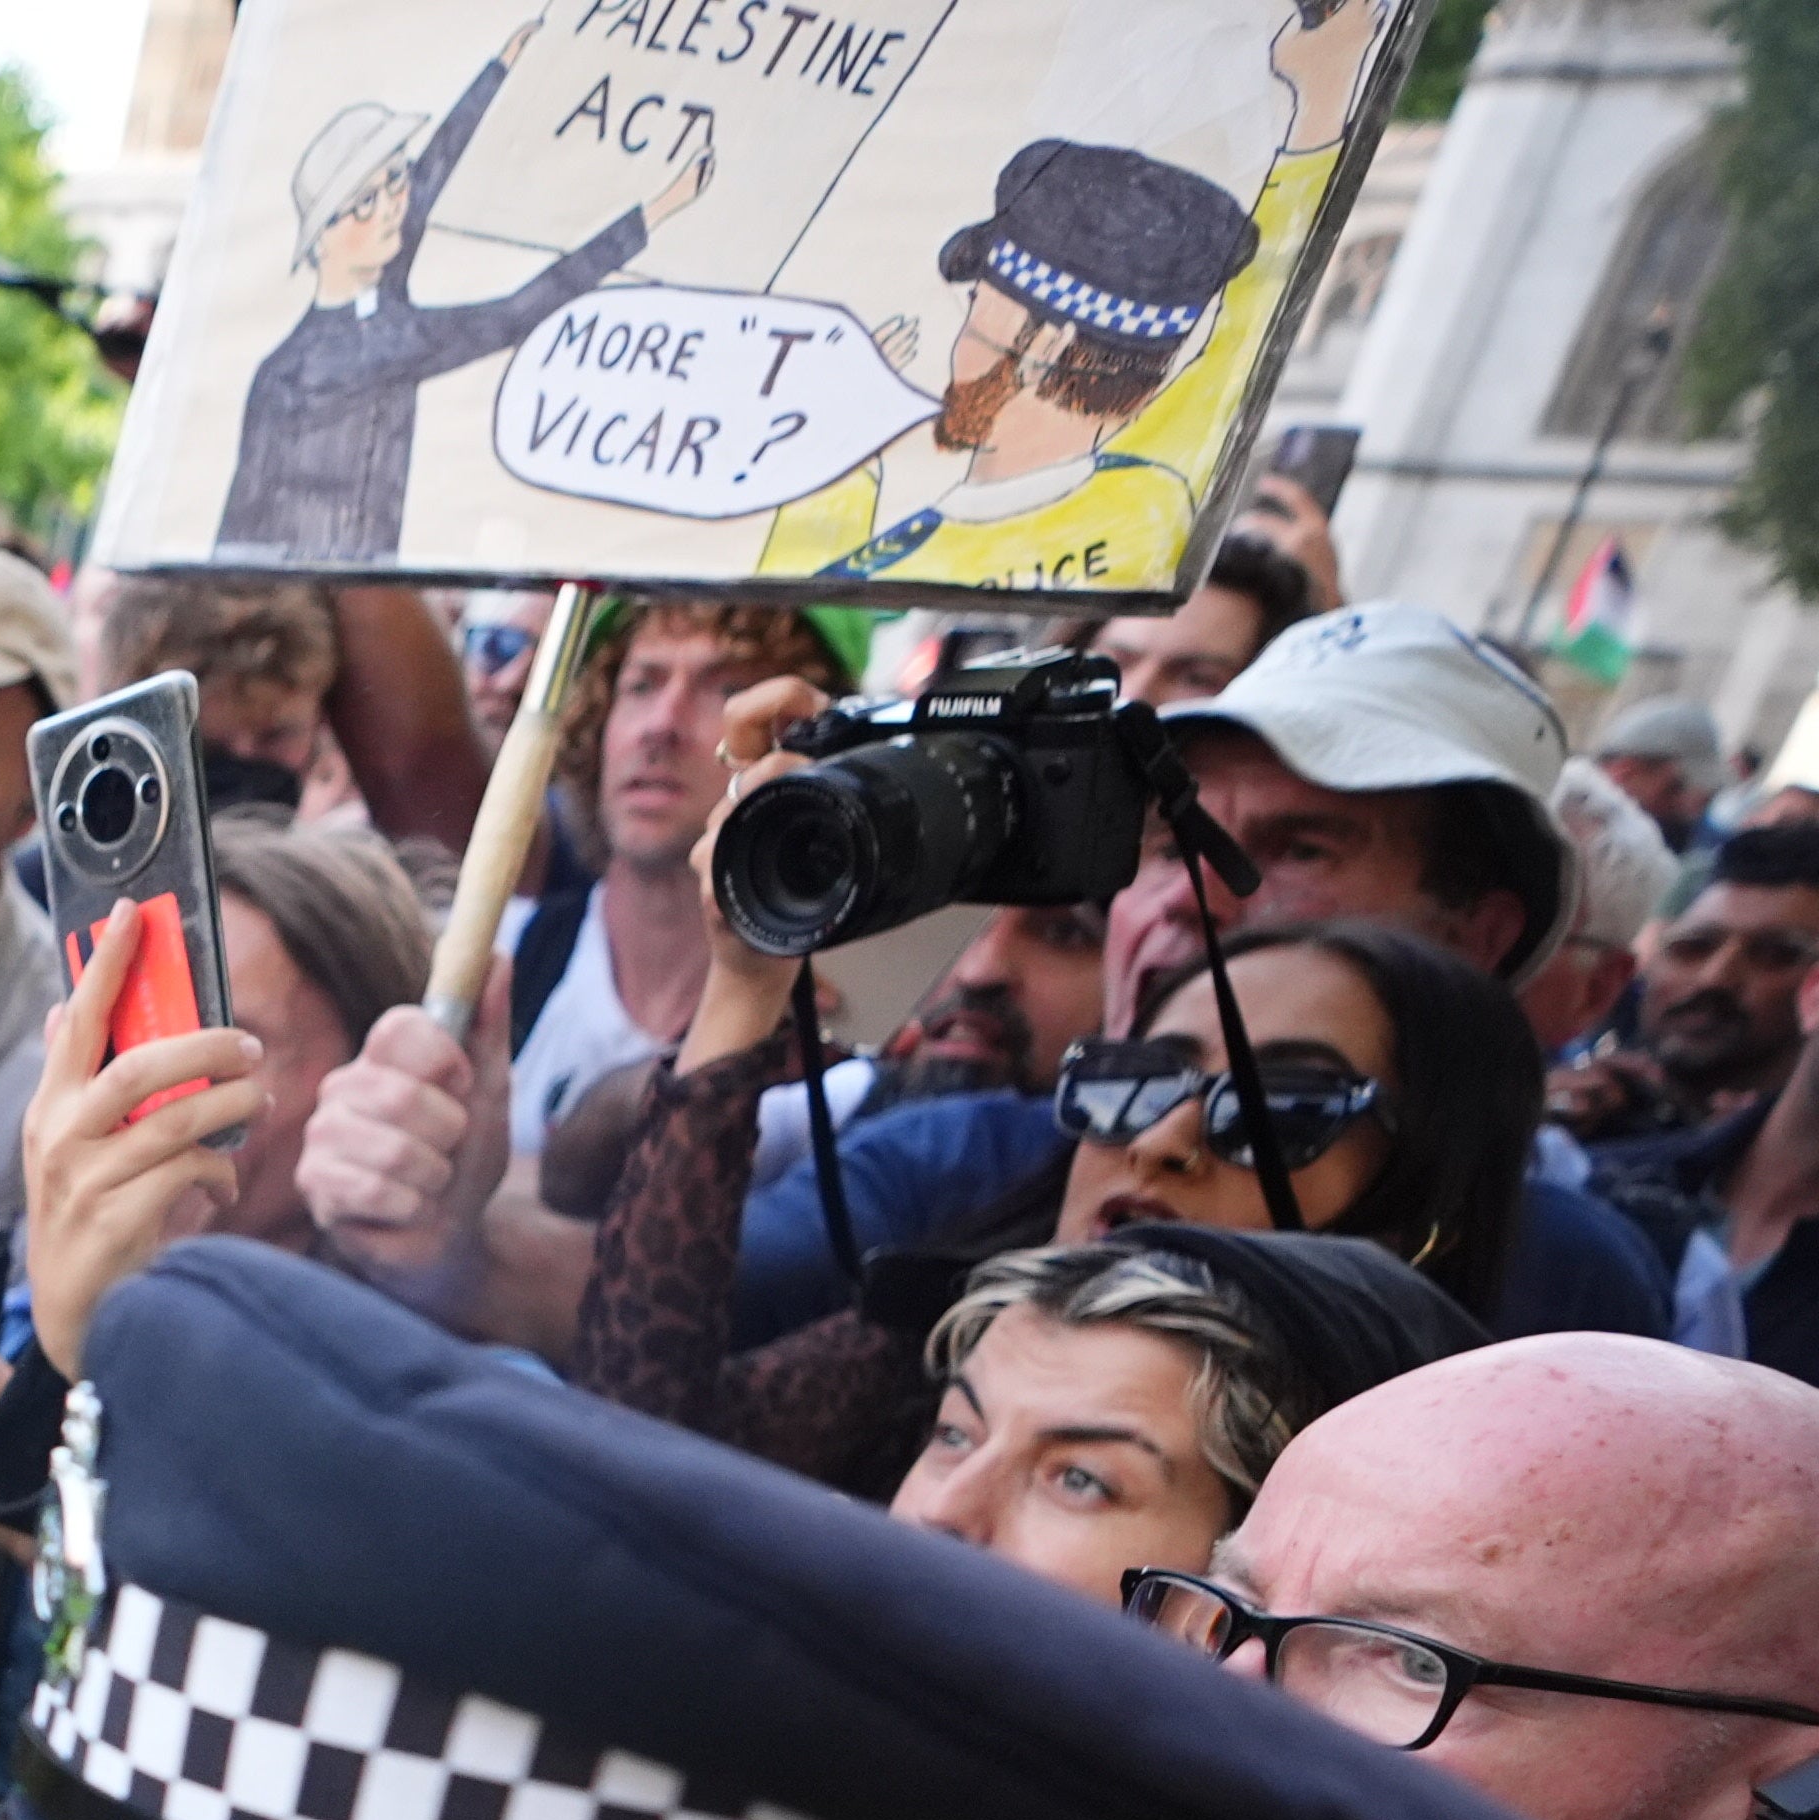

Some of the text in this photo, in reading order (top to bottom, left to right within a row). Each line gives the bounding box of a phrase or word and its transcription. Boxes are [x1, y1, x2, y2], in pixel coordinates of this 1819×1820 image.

[555, 74, 715, 163] ACT
[542, 312, 705, 382] MORE
[927, 696, 1002, 718] FUJIFILM
